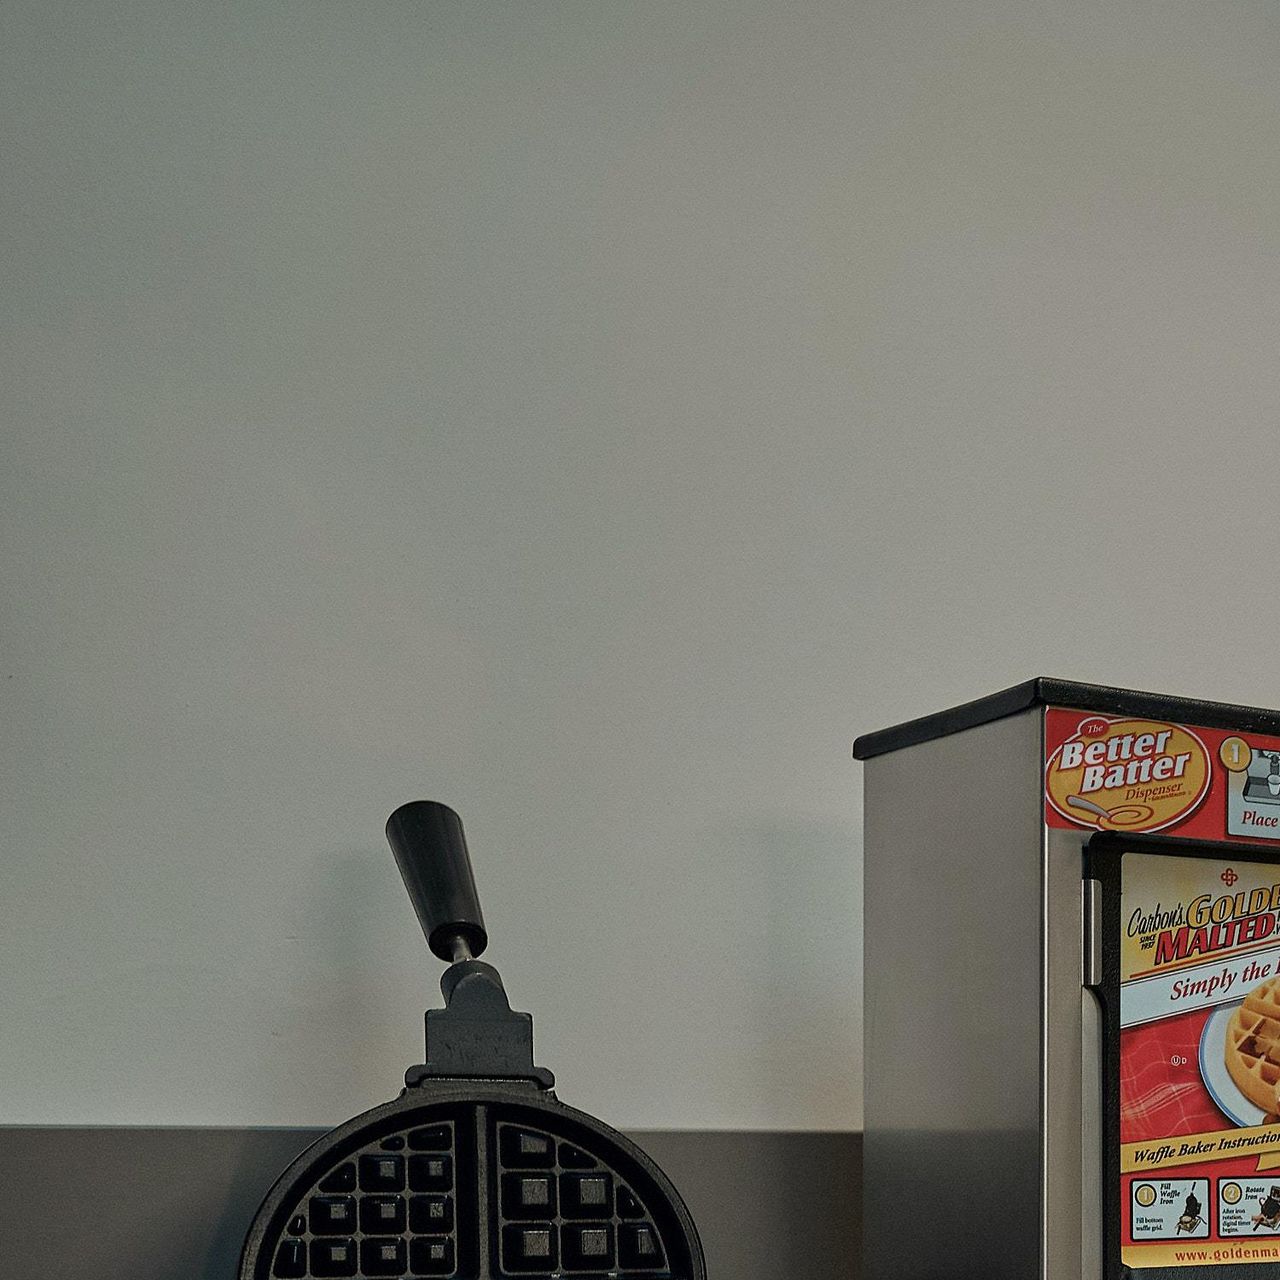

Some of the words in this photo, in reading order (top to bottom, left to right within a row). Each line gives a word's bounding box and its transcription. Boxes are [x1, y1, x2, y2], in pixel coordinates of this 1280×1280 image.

[1088, 724, 1103, 733] The
[1060, 729, 1172, 770] Better
[1231, 744, 1240, 763] 1
[1081, 753, 1190, 793] Batter
[1125, 782, 1183, 802] Dispenser
[1242, 810, 1278, 829] Place
[1139, 934, 1157, 943] SINCE
[1154, 913, 1276, 966] MALTED
[1170, 968, 1238, 1000] Simply
[1242, 962, 1270, 982] the
[1134, 1146, 1176, 1164] Waffle
[1177, 1141, 1216, 1157] Baker
[1160, 1190, 1180, 1198] Waffle
